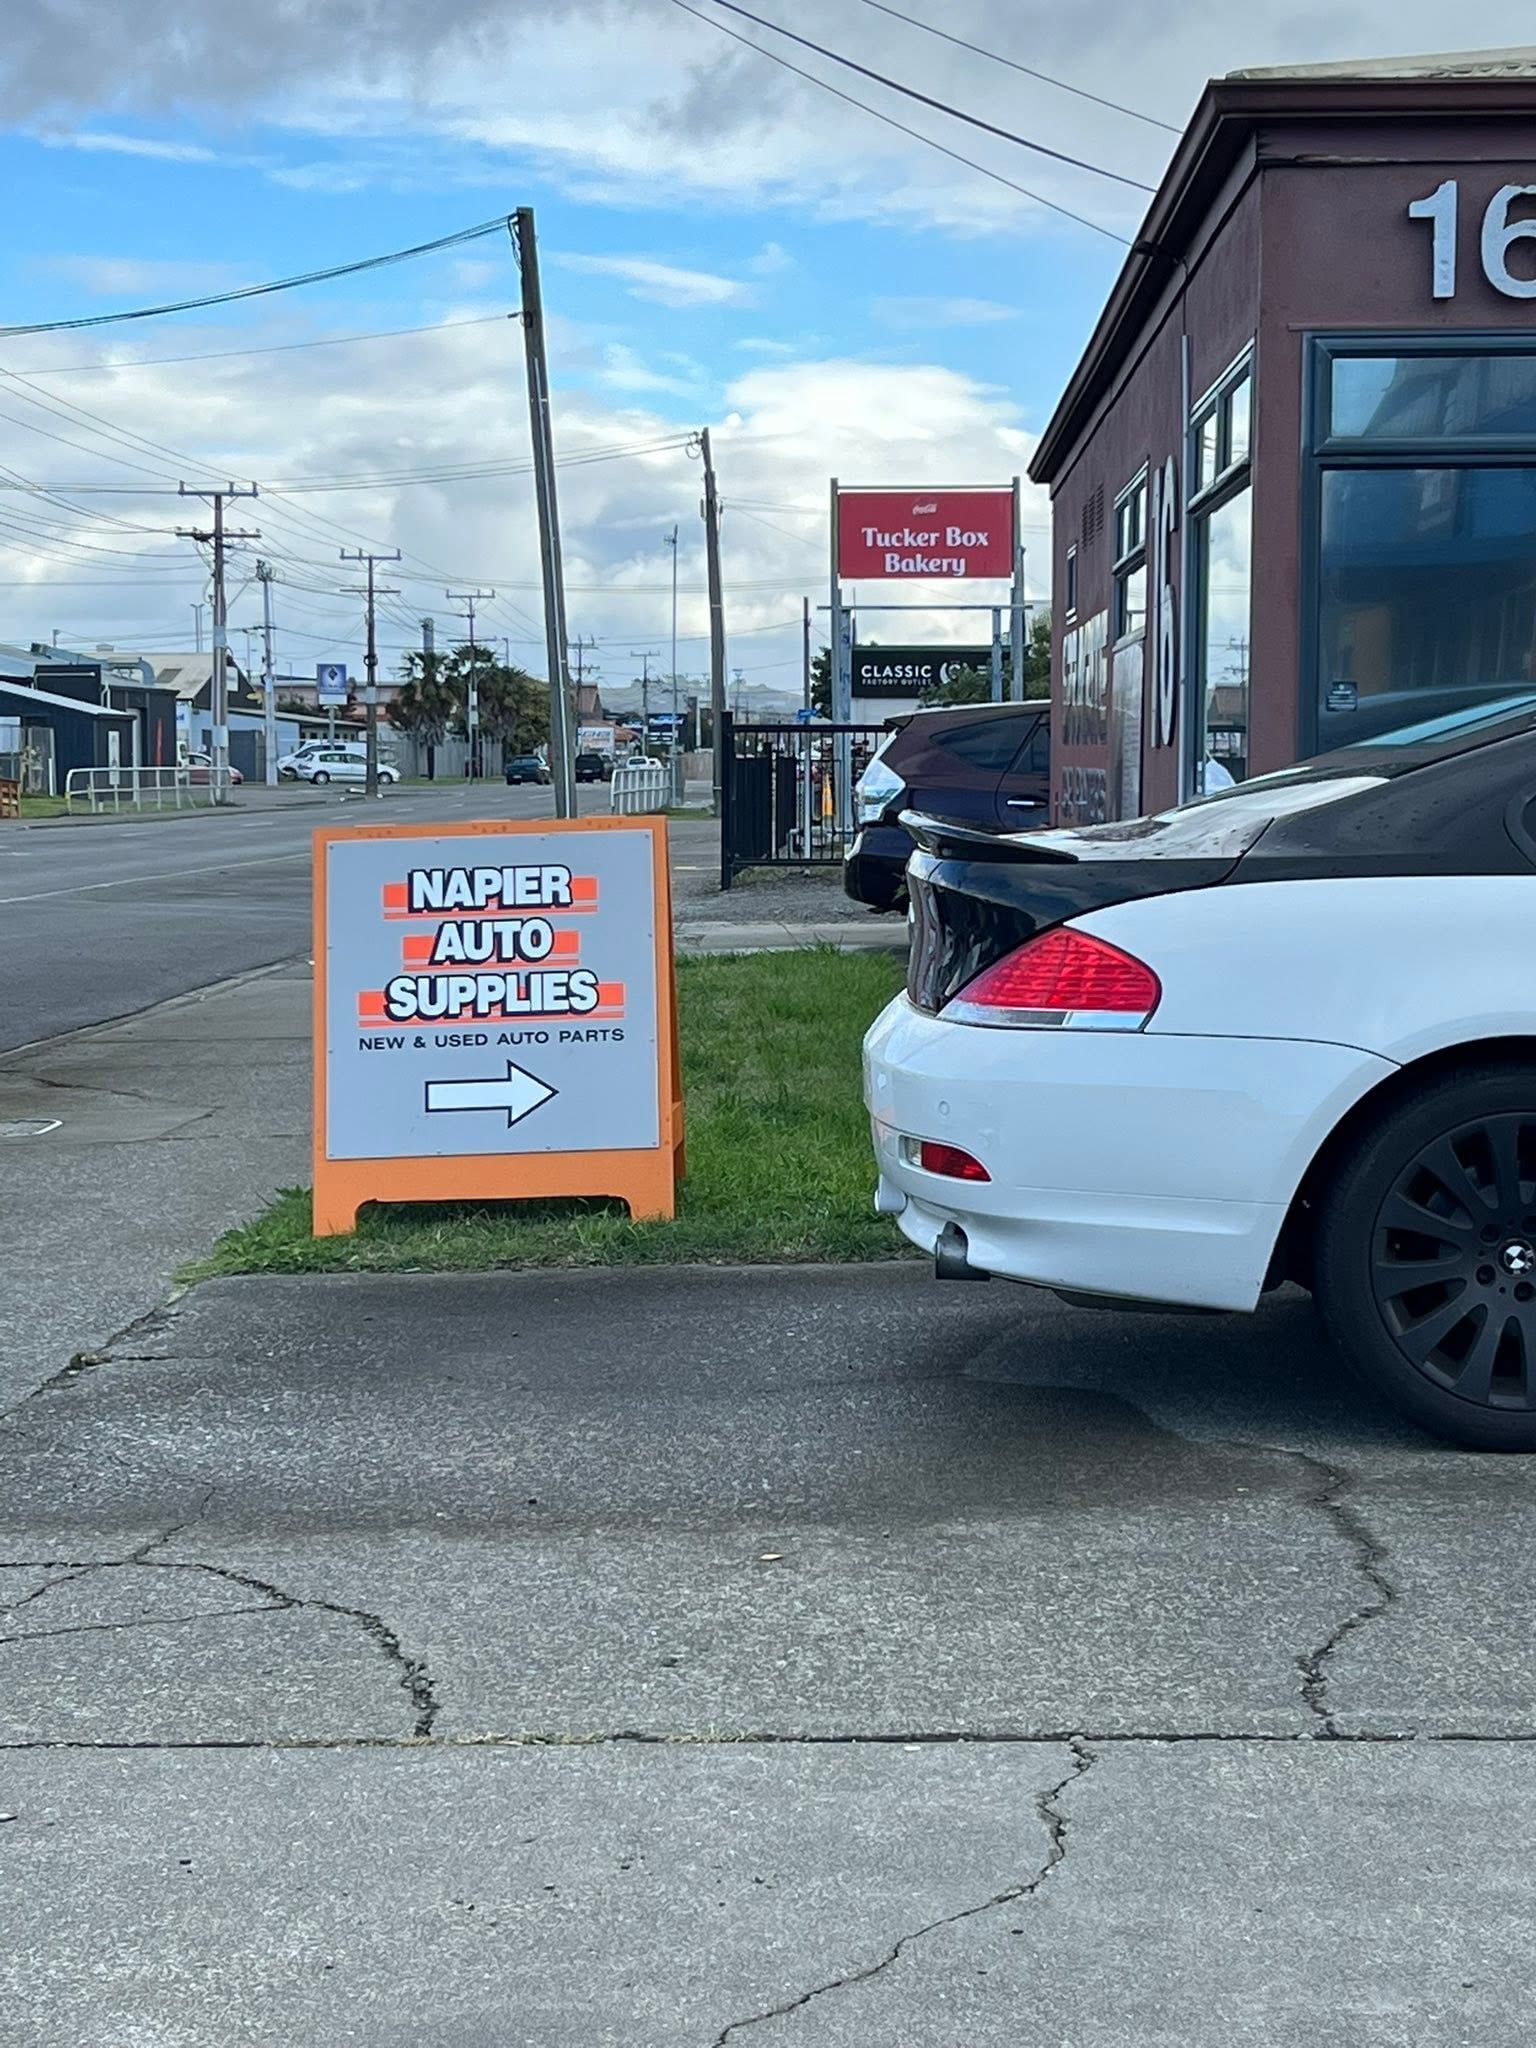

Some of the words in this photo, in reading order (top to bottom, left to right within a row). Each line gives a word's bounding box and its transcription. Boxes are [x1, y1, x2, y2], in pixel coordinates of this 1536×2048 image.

[861, 527, 940, 547] Tucker
[945, 526, 989, 547] Box
[884, 553, 966, 577] Bakery
[861, 665, 932, 678] CLASSIC
[408, 864, 573, 913] NAPIER
[428, 917, 555, 965] AUTO
[385, 969, 599, 1022] SUPPLIES
[359, 1036, 405, 1051] NEW
[413, 1036, 426, 1049] &
[435, 1033, 488, 1048] USED
[496, 1030, 549, 1046] AUTO
[558, 1028, 625, 1044] PARTS
